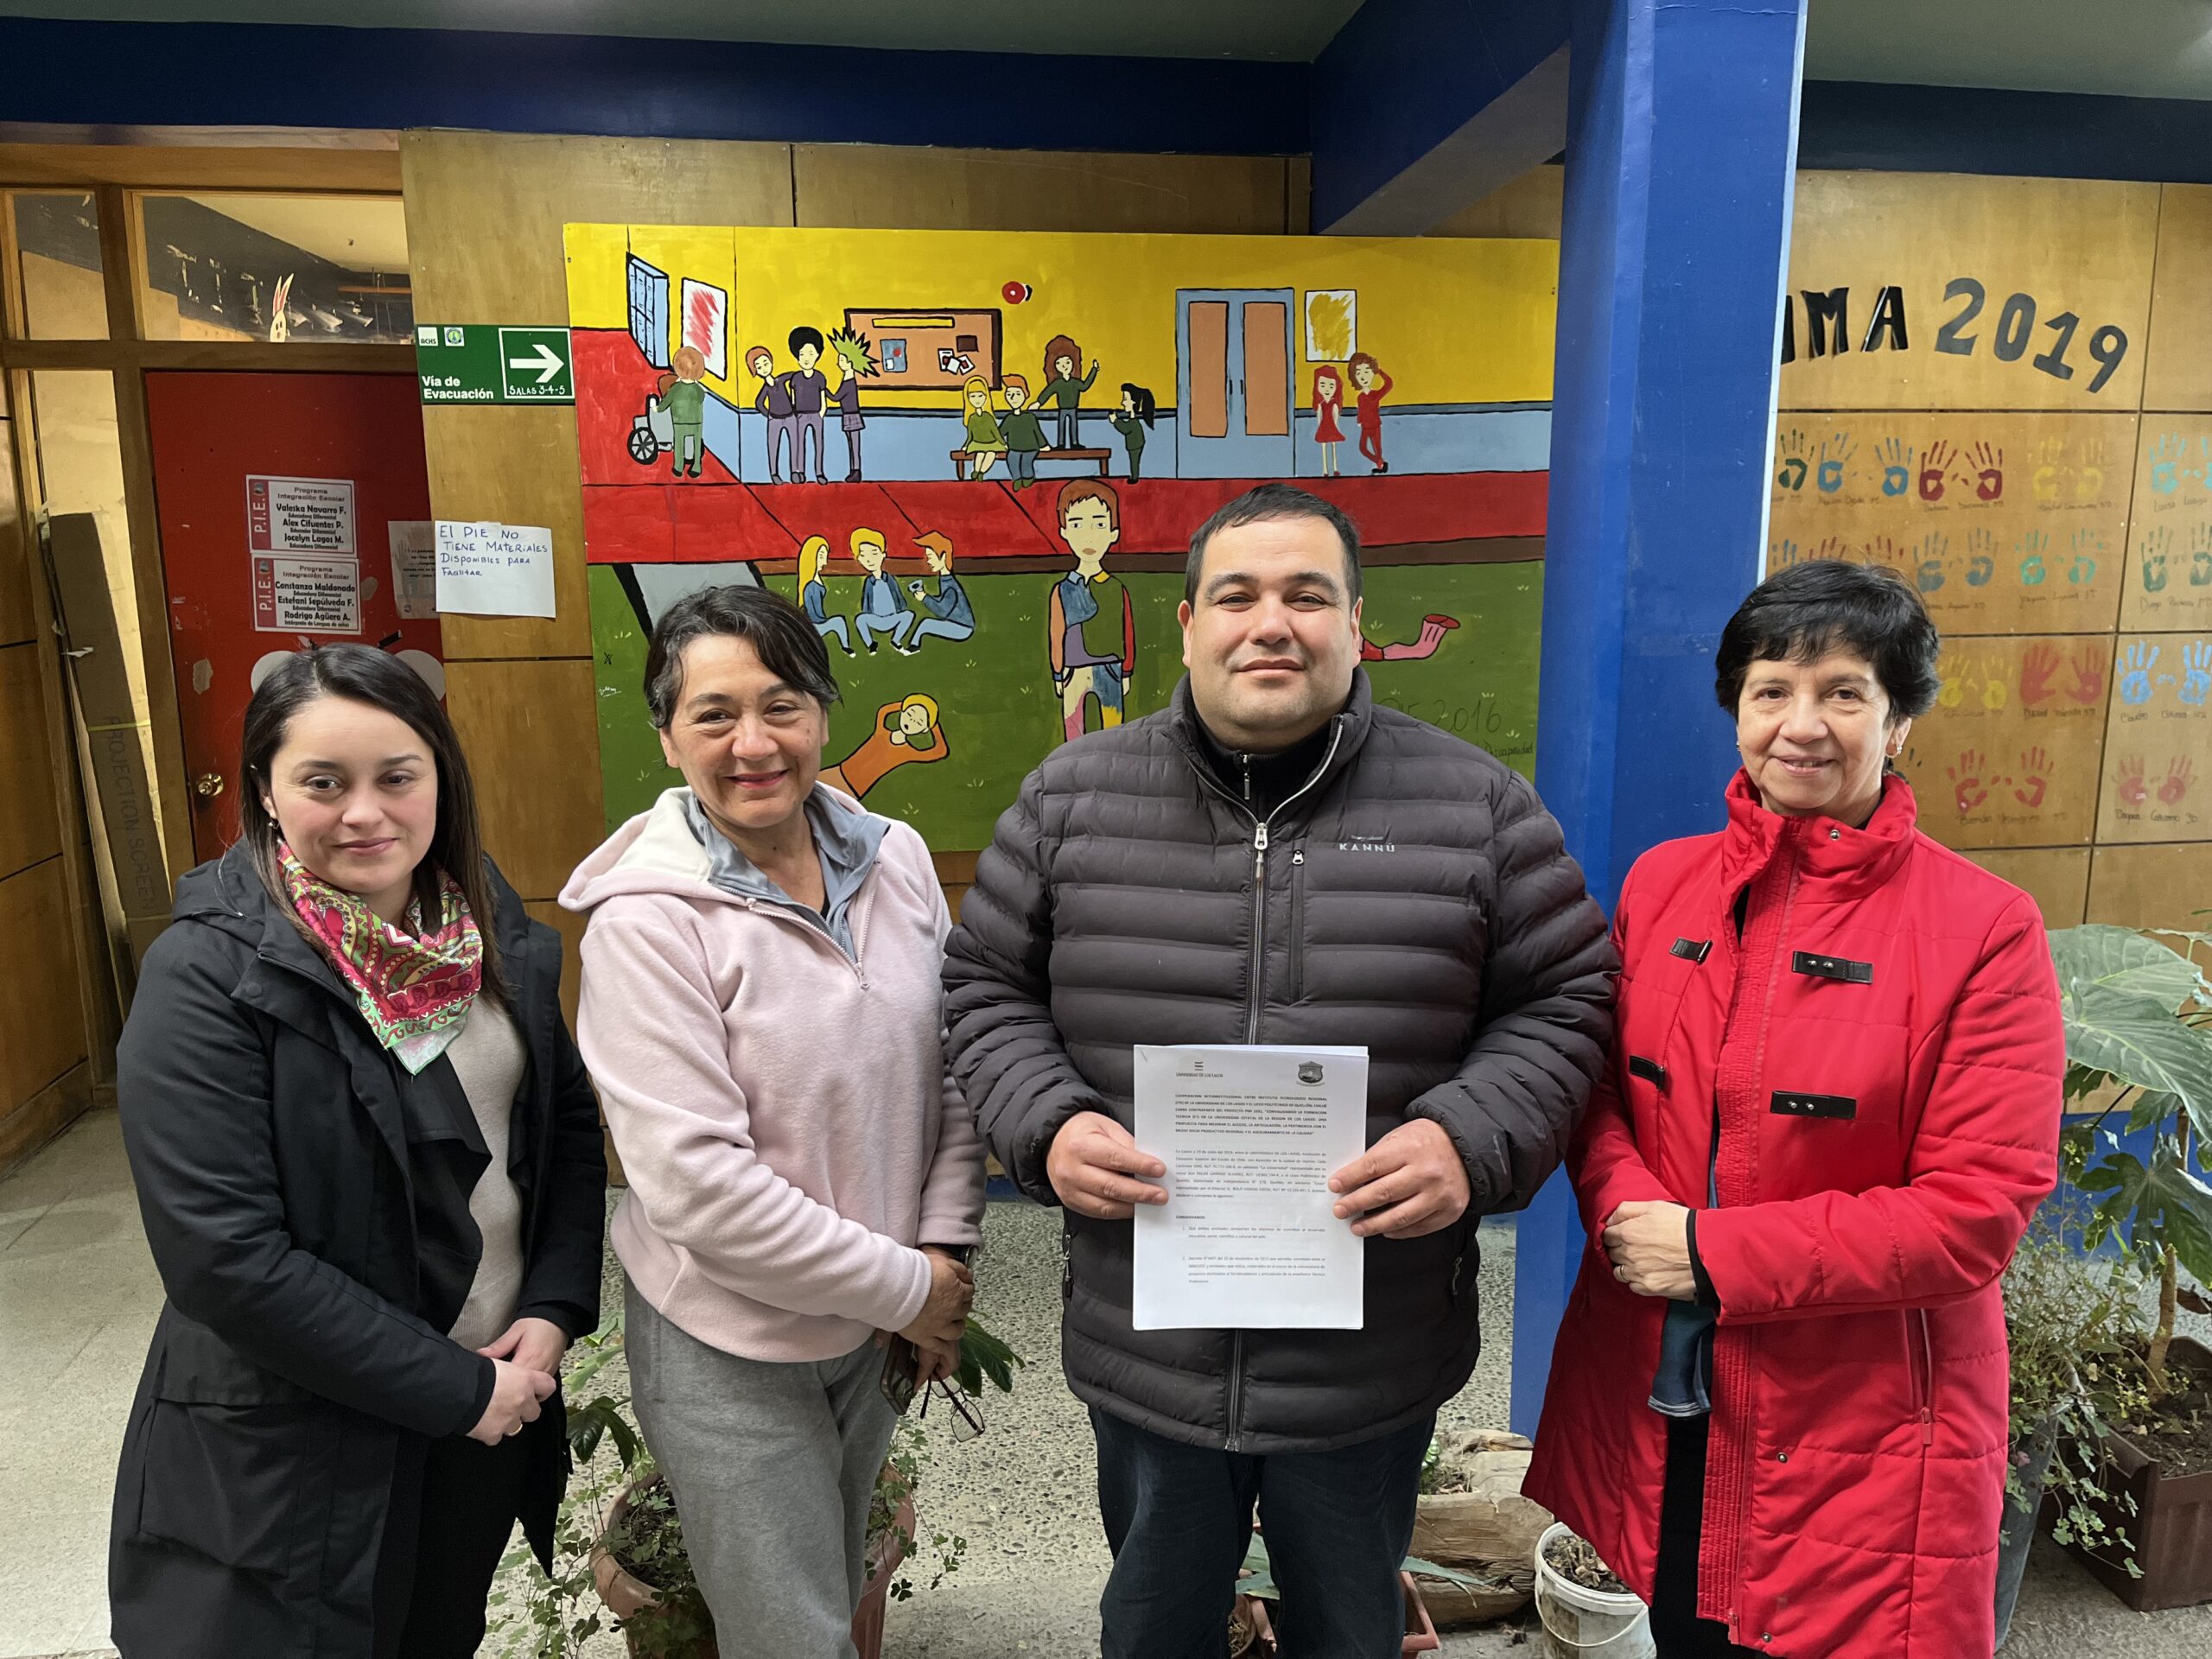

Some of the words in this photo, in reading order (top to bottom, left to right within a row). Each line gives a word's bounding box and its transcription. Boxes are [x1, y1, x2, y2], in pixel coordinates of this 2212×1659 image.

[1935, 277, 2128, 393] 2019
[422, 376, 442, 386] Vía
[445, 376, 461, 386] de
[424, 388, 494, 399] Evacuación
[509, 385, 537, 395] SALAS
[539, 385, 565, 395] 3-4-5
[276, 503, 305, 512] Valeska
[307, 505, 337, 514] Navarro
[339, 506, 346, 514] F.
[253, 498, 267, 533] P.I.E.
[283, 519, 299, 527] Alex
[300, 520, 334, 528] Cifuentes
[285, 533, 310, 543] Jocelyn
[312, 534, 333, 543] Lagos
[464, 526, 488, 538] PIE
[502, 530, 519, 539] NO
[275, 581, 313, 590] Constanza
[315, 583, 356, 592] Maldonado
[258, 577, 272, 611] P.I.E.
[309, 597, 345, 606] Sepúlveda
[285, 611, 313, 620] Rodrigo
[315, 612, 341, 621] Agüero
